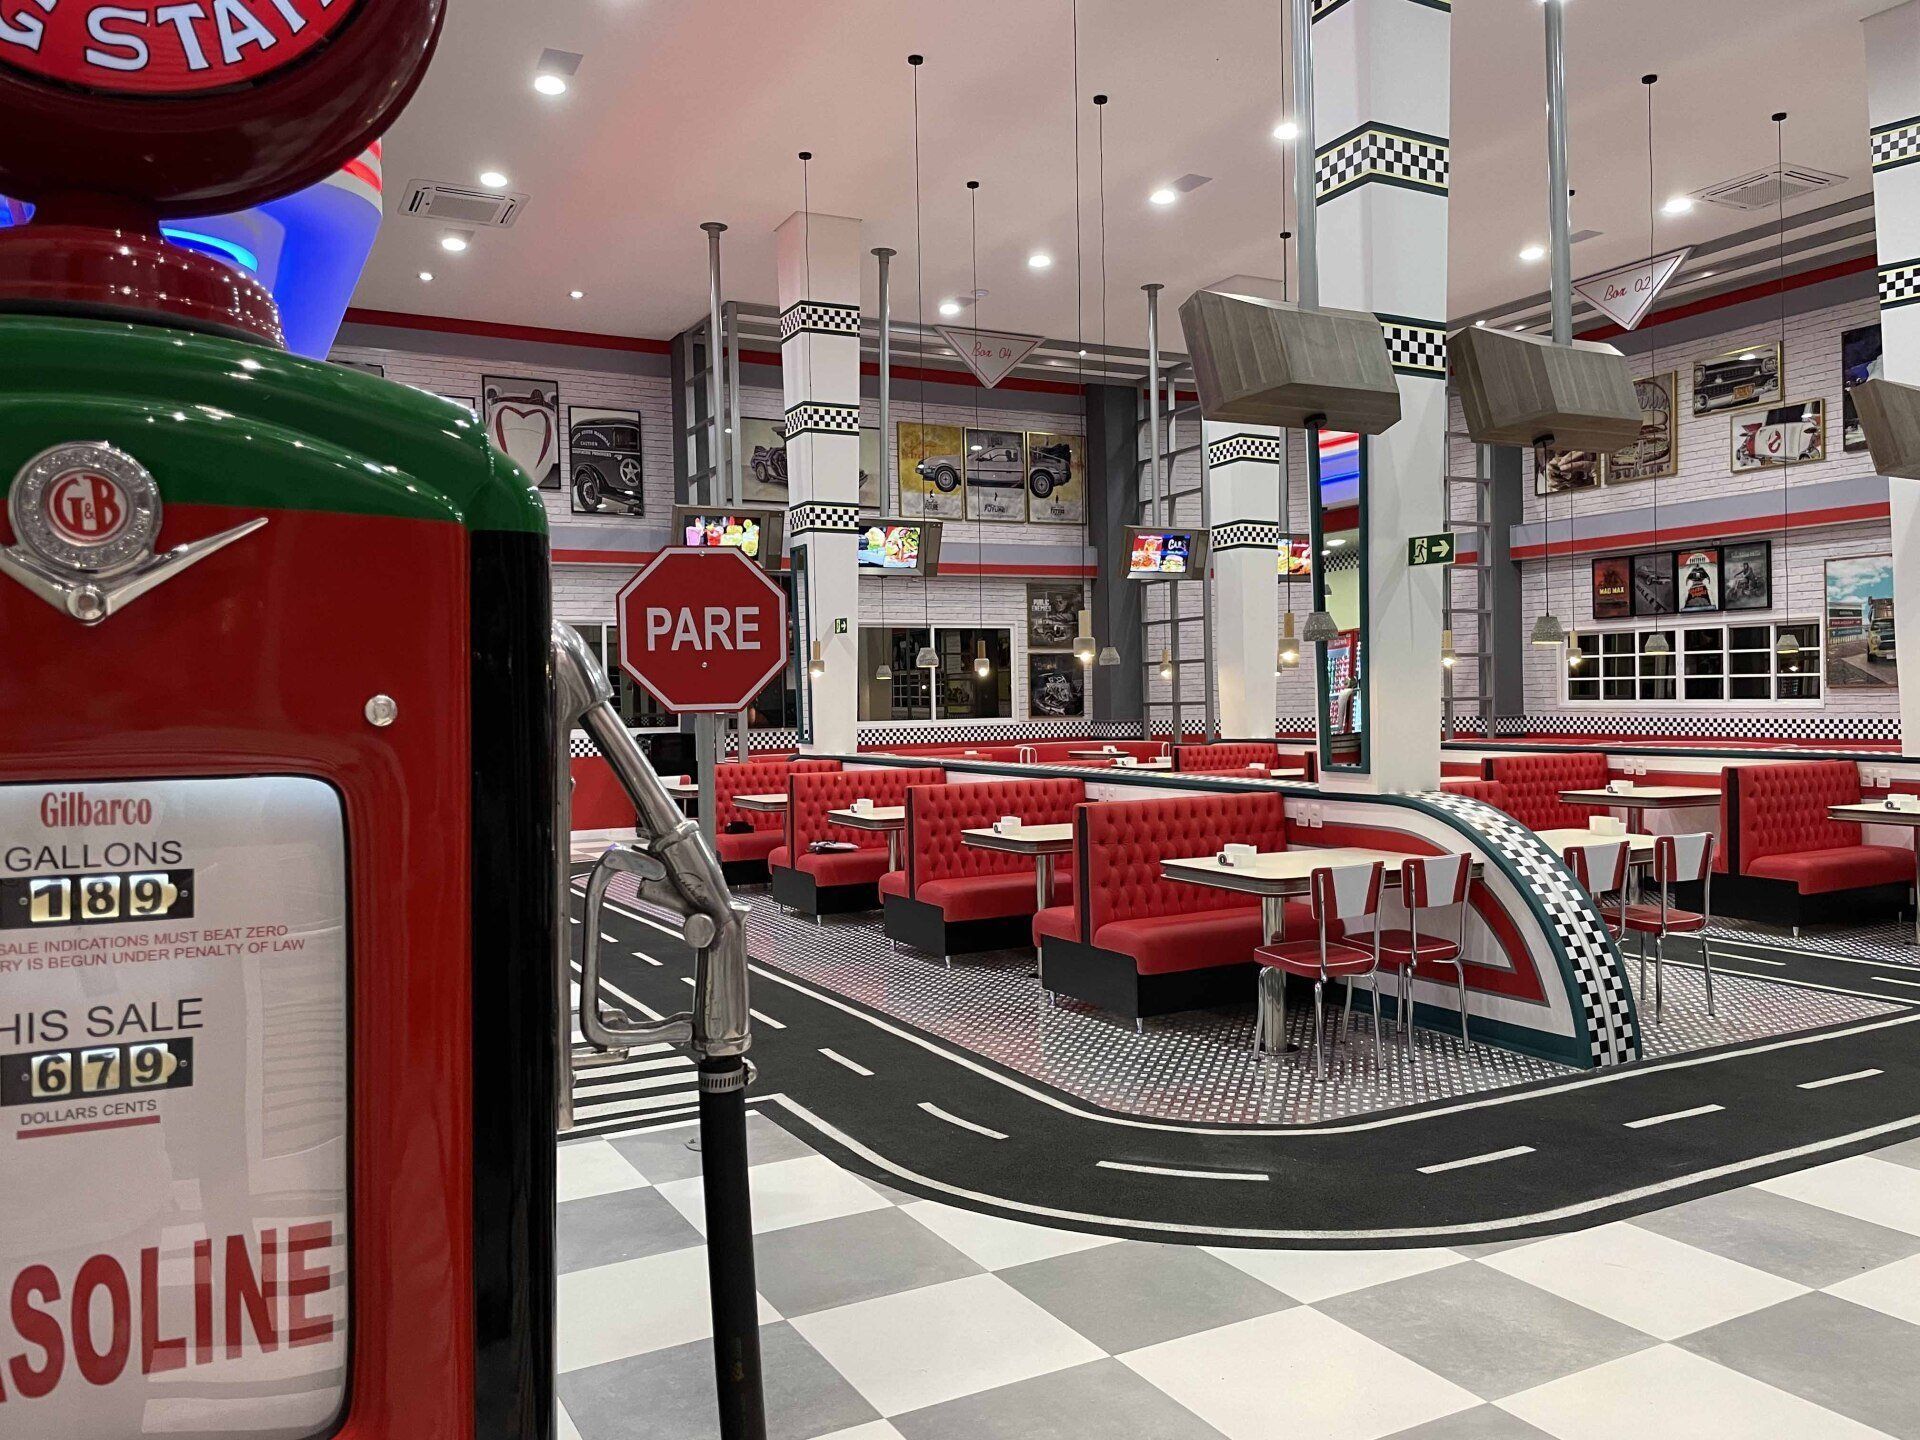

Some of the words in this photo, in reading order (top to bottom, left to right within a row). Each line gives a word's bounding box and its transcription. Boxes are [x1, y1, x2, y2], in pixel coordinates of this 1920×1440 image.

[1603, 284, 1628, 301] Box
[1634, 276, 1651, 292] 02
[1612, 586, 1625, 594] MAX
[646, 606, 761, 652] PARE
[40, 792, 152, 828] Gilbarco
[4, 840, 184, 872] GALLONS
[0, 943, 38, 956] SALE
[44, 934, 149, 953] INDICATIONS
[154, 930, 200, 945] MUST
[203, 927, 244, 942] BEAT
[246, 925, 289, 938] ZERO
[27, 957, 44, 971] IS
[48, 952, 108, 969] BEGUN
[112, 948, 170, 964] UNDER
[174, 942, 244, 959] PENALTY
[250, 941, 270, 953] OF
[273, 938, 306, 951] LAW
[86, 997, 204, 1038] SALE
[21, 1105, 98, 1126] DOLLARS
[103, 1099, 157, 1117] CENTS
[0, 1220, 334, 1401] SOLINE
